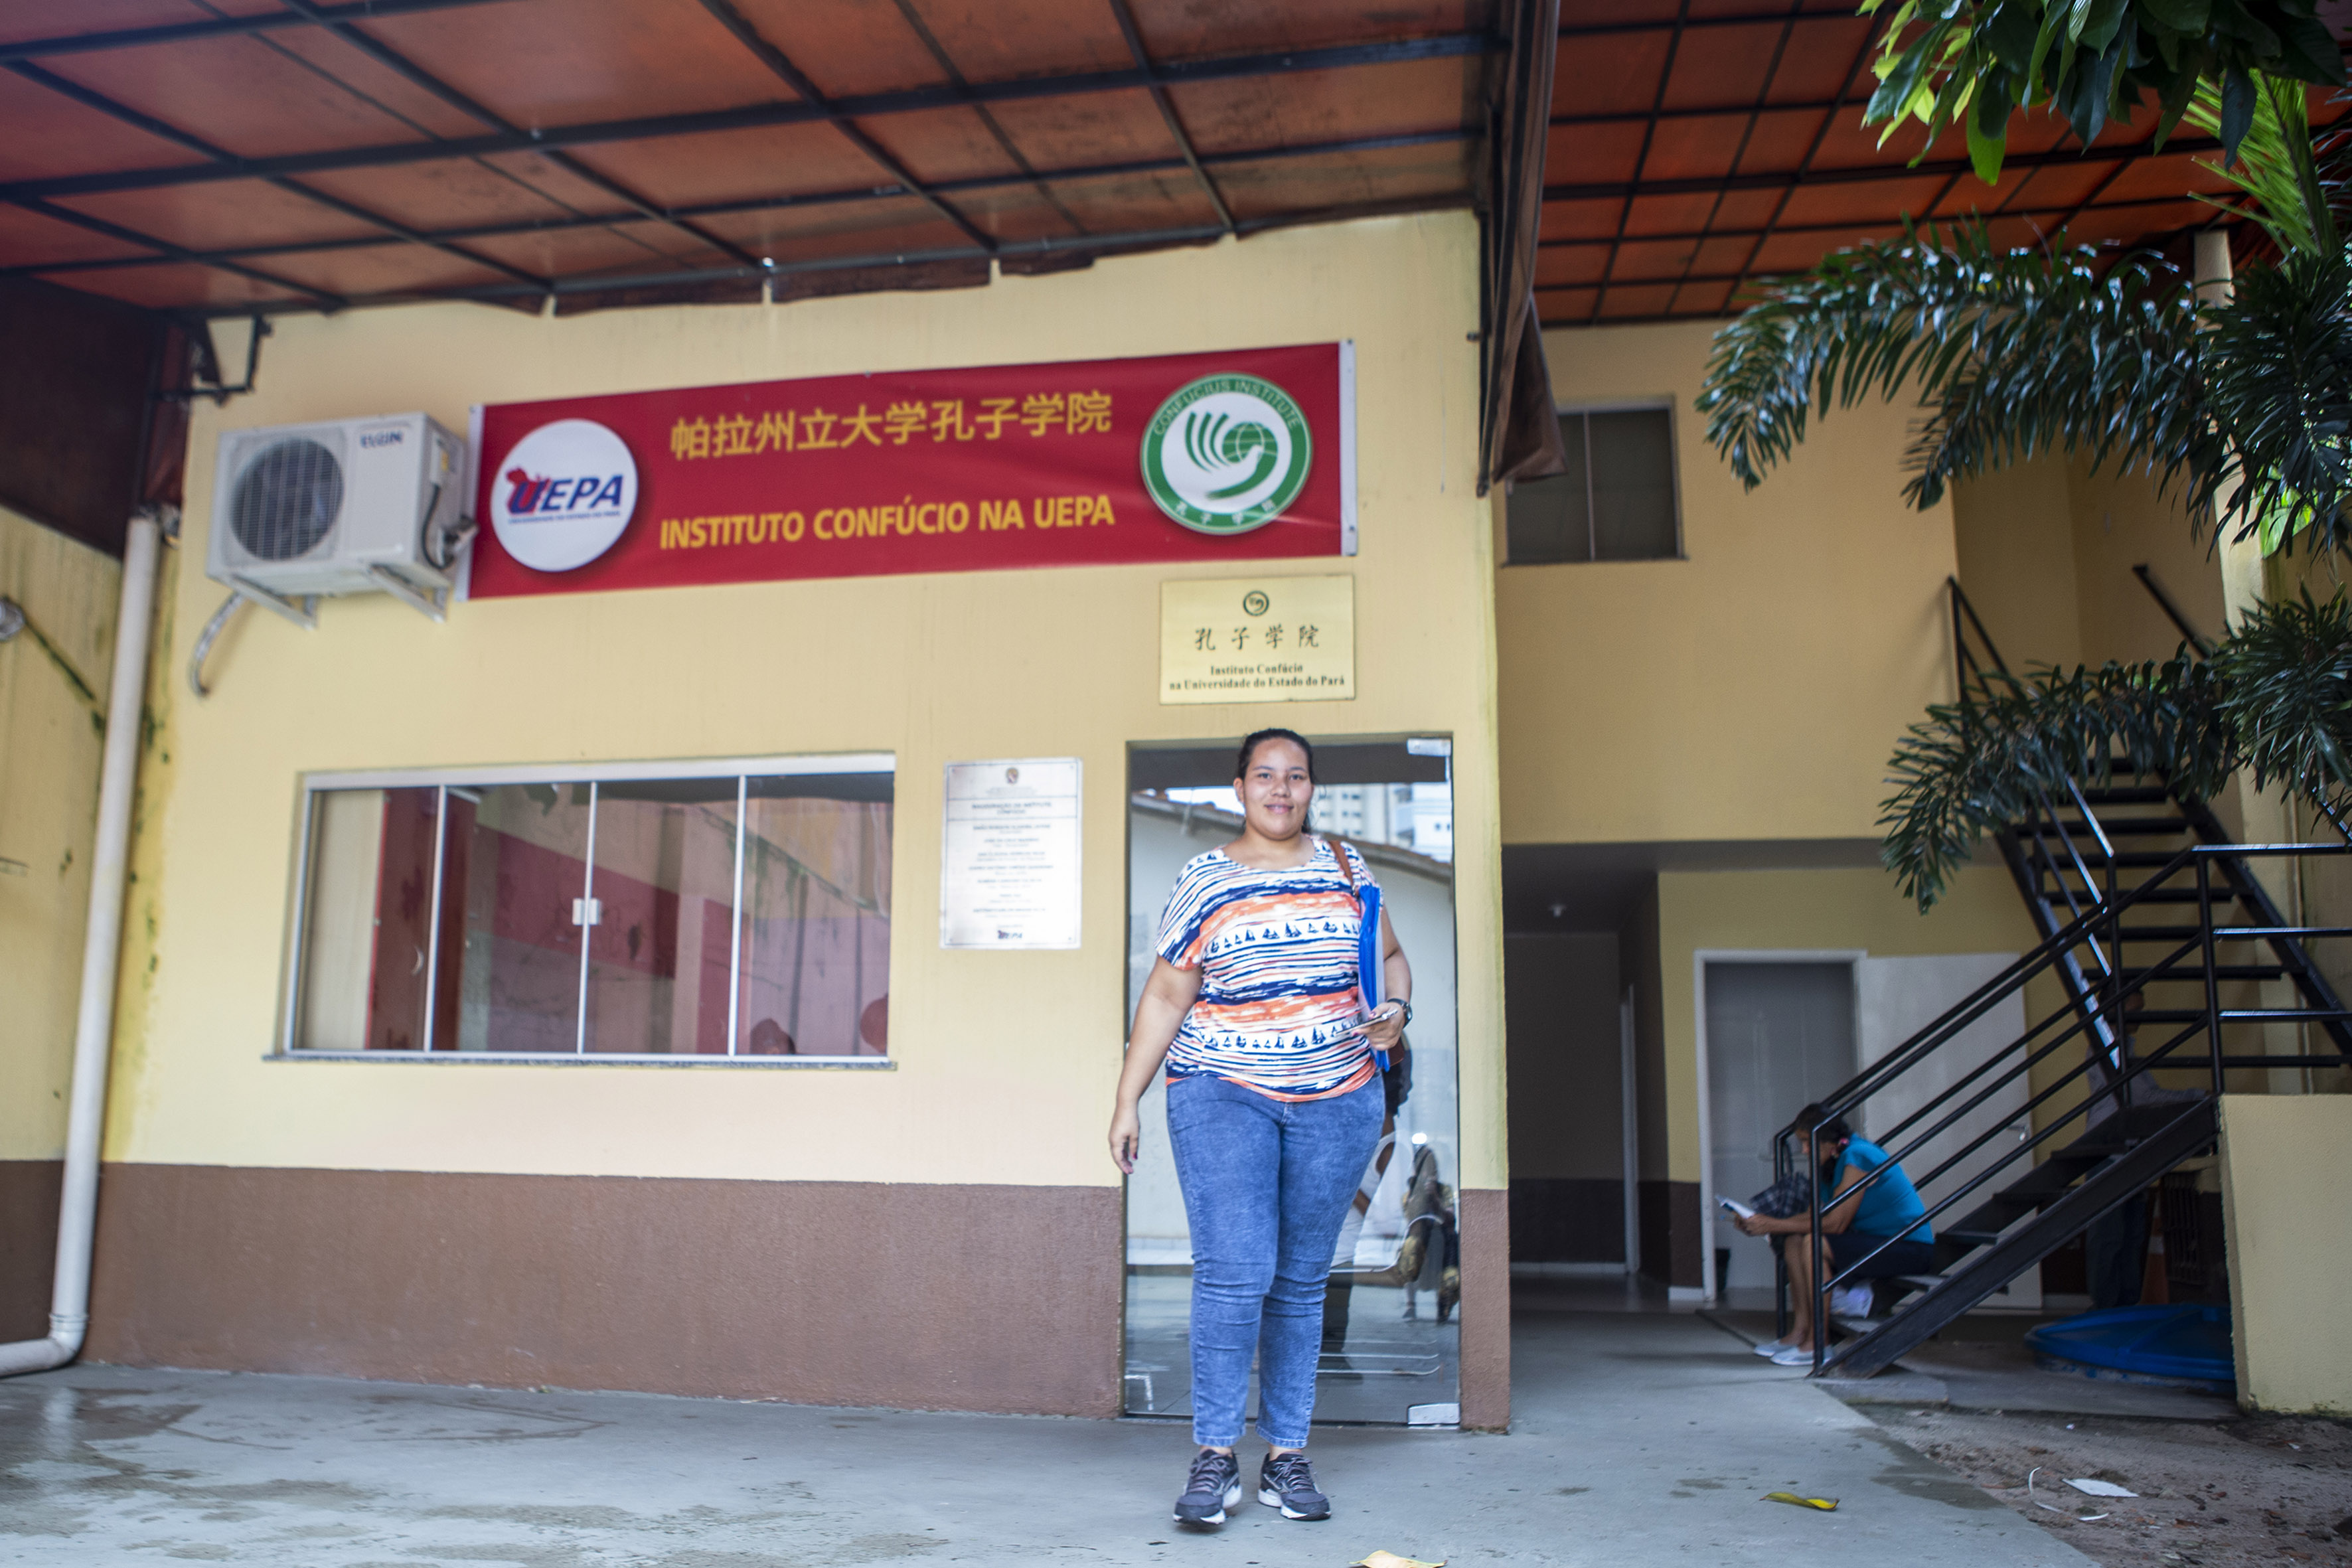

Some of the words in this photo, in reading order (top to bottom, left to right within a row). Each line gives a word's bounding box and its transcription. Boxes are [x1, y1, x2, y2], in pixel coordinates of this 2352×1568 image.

[670, 390, 1112, 461] 帕拉州立大学孔子学院
[1154, 380, 1231, 435] CONFUCIUS
[1235, 380, 1300, 429] INSTITUTE
[508, 473, 623, 514] UEPA
[660, 510, 805, 550] INSTITUTO
[813, 495, 970, 540] CONFÚCIO
[979, 499, 1025, 531] NA
[1033, 495, 1115, 528] UEPA
[1195, 623, 1319, 651] 孔子学院
[1170, 682, 1181, 690] na
[1184, 678, 1251, 690] Universidade
[1253, 677, 1265, 688] do
[1269, 676, 1303, 687] Estado
[1306, 676, 1318, 686] do
[1321, 674, 1344, 686] Pará
[1210, 665, 1254, 675] Instituto
[1257, 663, 1303, 674] Confúcio
